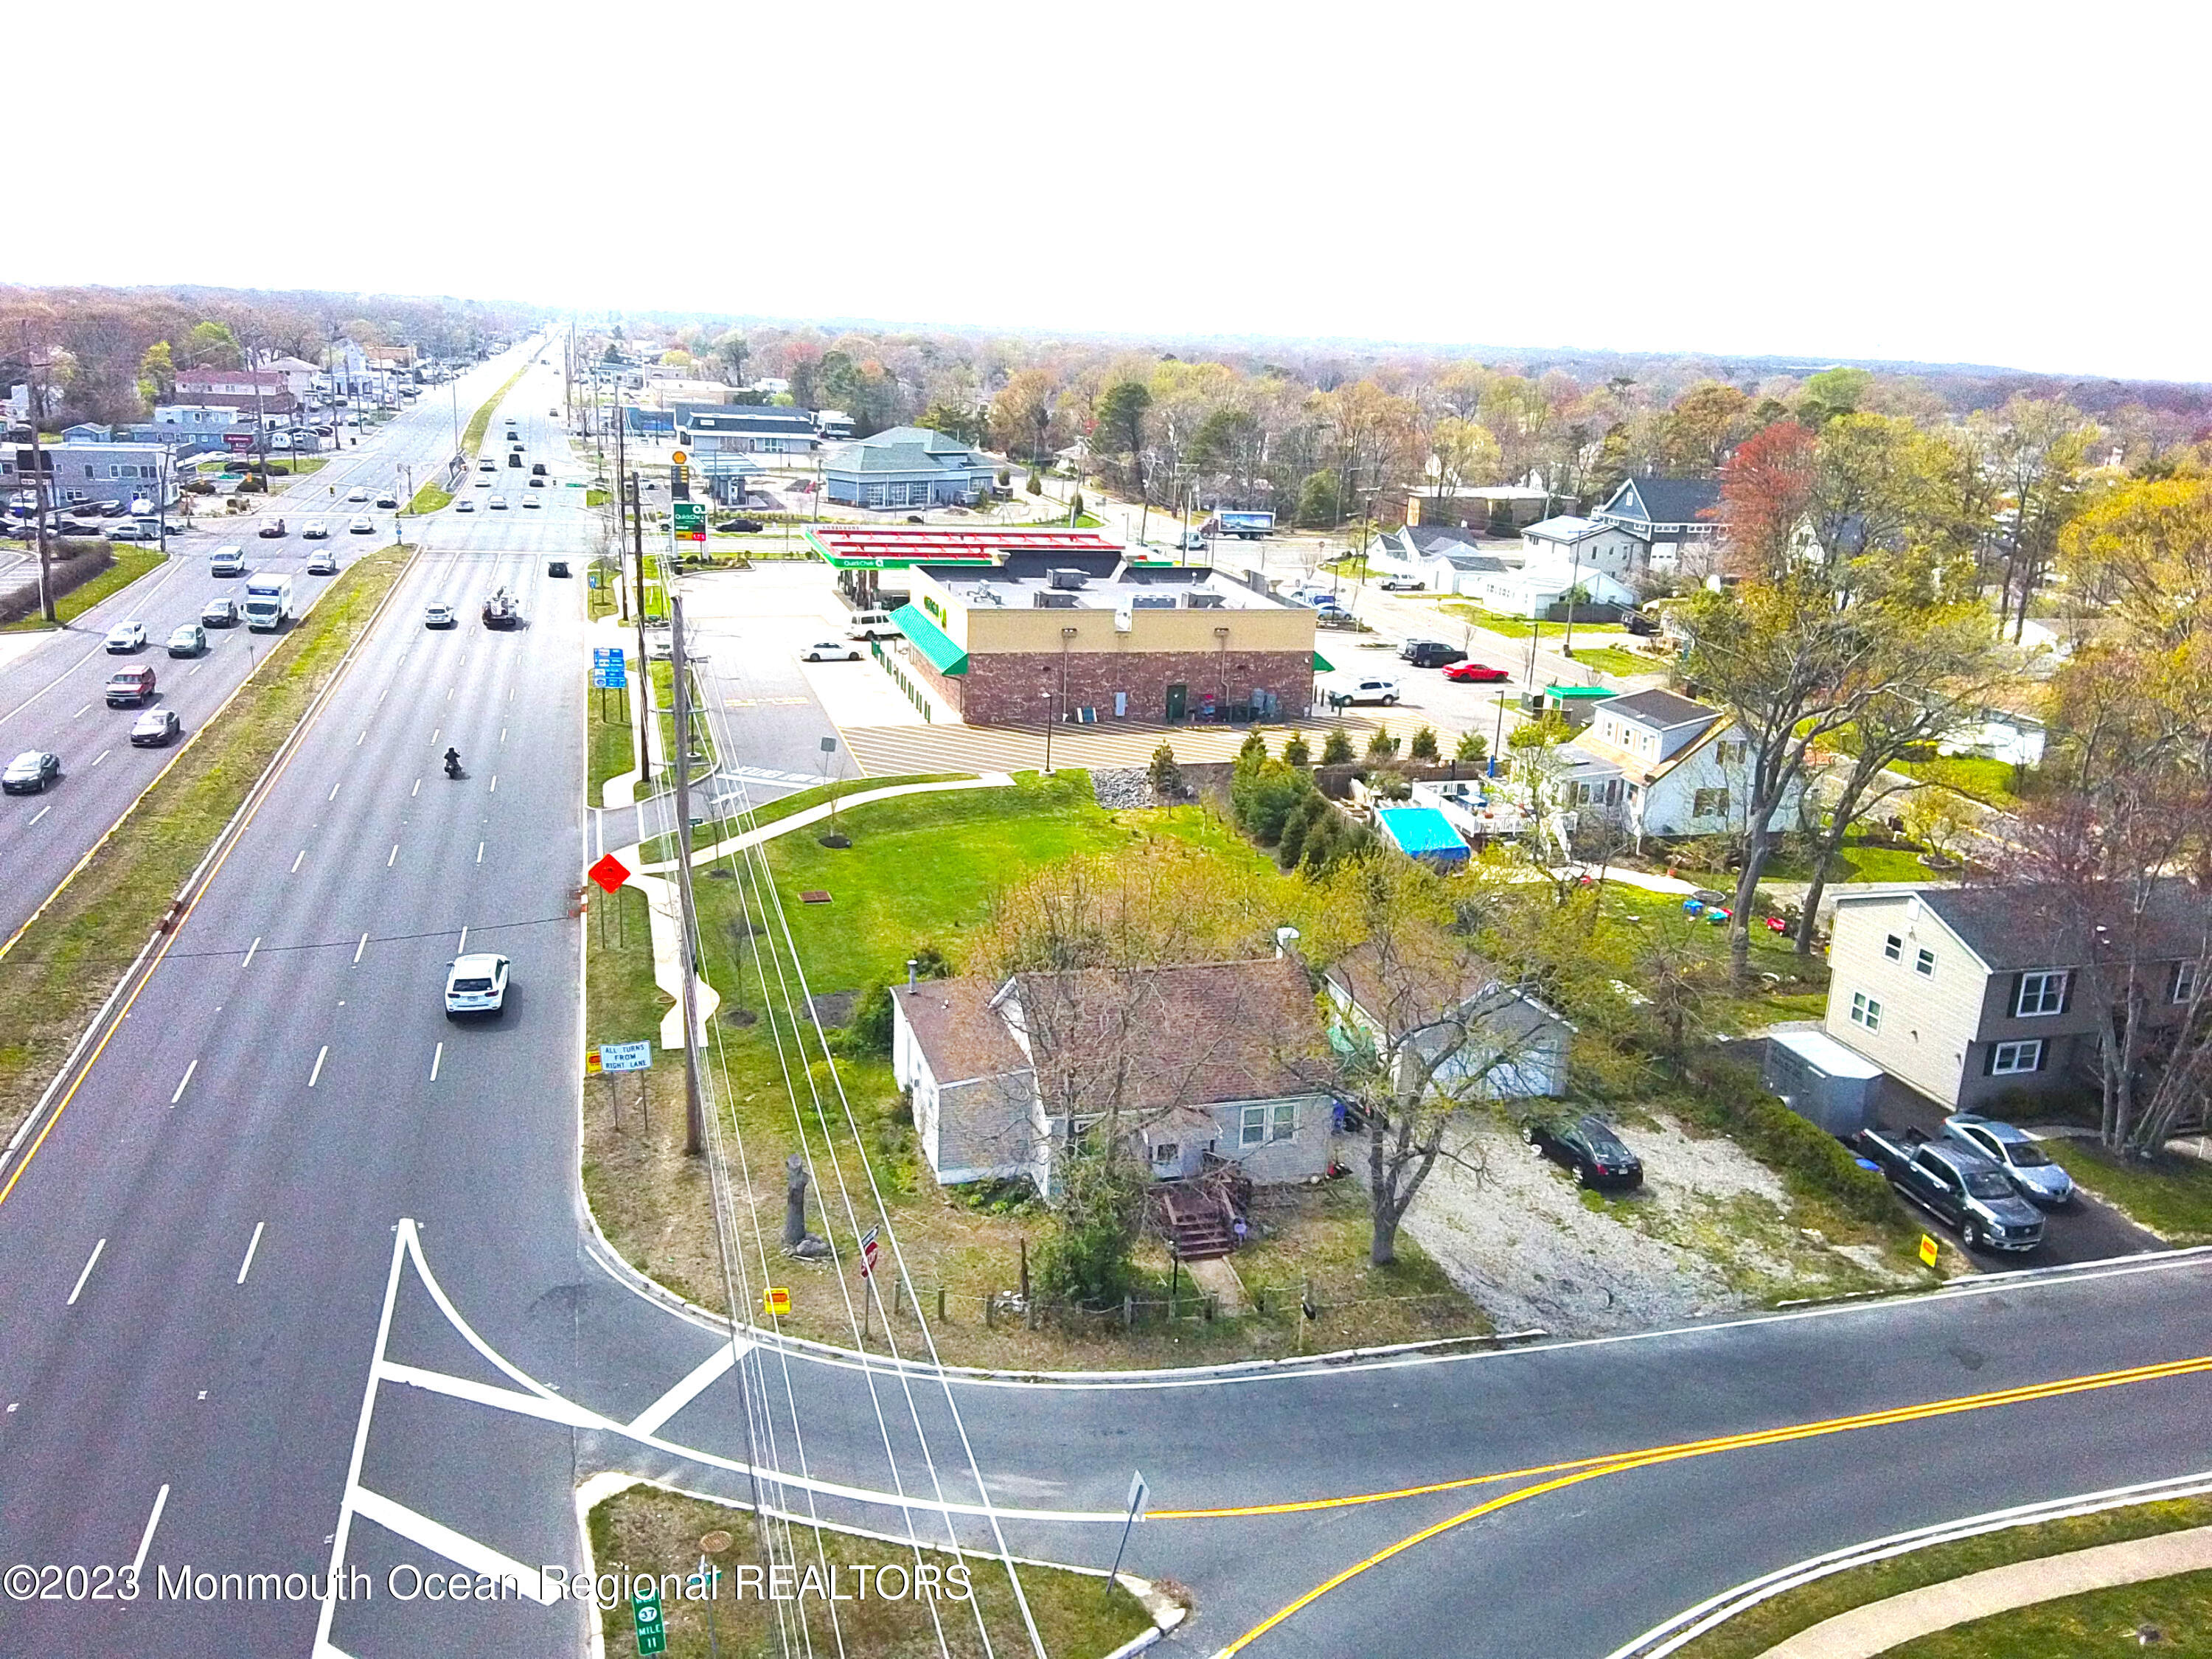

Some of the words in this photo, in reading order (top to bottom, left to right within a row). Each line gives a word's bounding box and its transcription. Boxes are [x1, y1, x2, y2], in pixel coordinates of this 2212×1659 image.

[622, 1044, 644, 1053] TURNS
[630, 1060, 647, 1068] LANE
[641, 1609, 655, 1620] 37
[639, 1624, 661, 1636] MILE
[647, 1637, 657, 1649] 11
